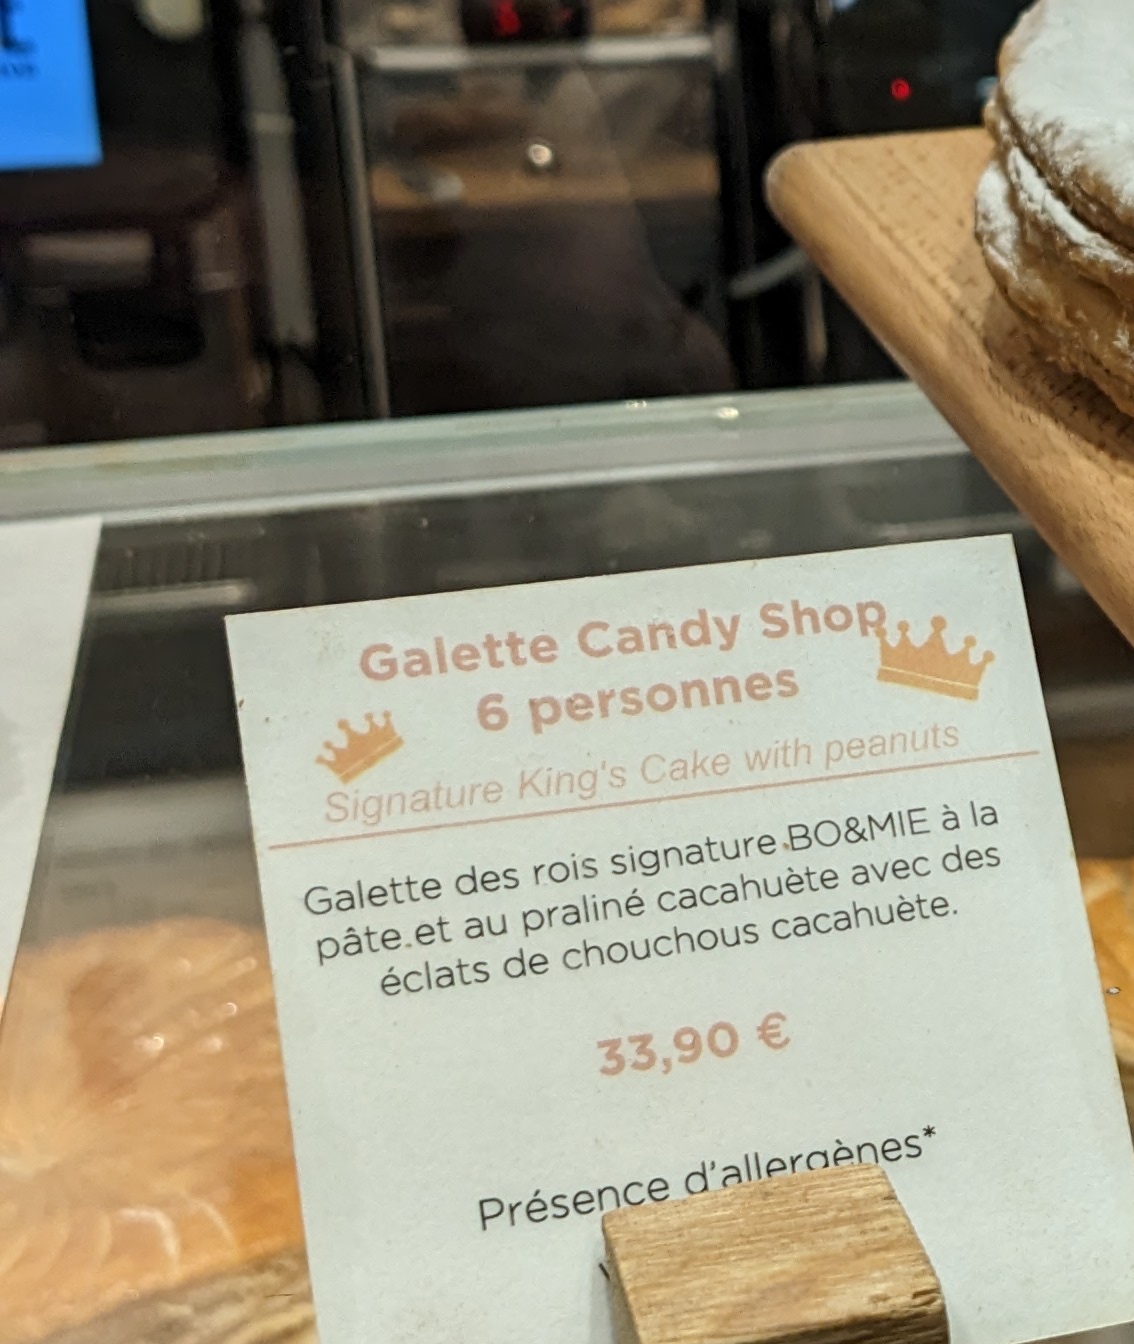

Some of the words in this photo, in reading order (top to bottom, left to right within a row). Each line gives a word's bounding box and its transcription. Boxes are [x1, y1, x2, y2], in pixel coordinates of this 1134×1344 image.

[359, 631, 559, 682] Galette
[576, 608, 741, 659] Candy
[758, 598, 887, 640] Shop
[476, 692, 509, 733] 6
[528, 669, 801, 735] personnes
[325, 780, 503, 826] Signature
[518, 760, 627, 801] King's
[640, 750, 732, 785] Cake
[744, 737, 812, 772] with
[825, 720, 961, 768] peanuts
[303, 873, 443, 915] Galette
[454, 865, 521, 897] des
[533, 852, 599, 886] rois
[610, 833, 778, 878] signature
[787, 806, 932, 852] BO&MIE
[941, 803, 962, 832] à
[969, 800, 999, 828] la
[316, 926, 402, 967] pâte
[415, 915, 453, 946] et
[464, 913, 509, 940] au
[521, 887, 646, 938] praliné
[656, 866, 840, 913] cacahuète
[851, 854, 932, 886] avec
[941, 844, 1002, 874] des
[380, 958, 491, 997] éclats
[503, 947, 550, 979] de
[562, 923, 760, 971] chouchous
[771, 894, 959, 941] cacahuète.
[597, 1020, 740, 1076] 33,90
[756, 1011, 791, 1050] €
[478, 1173, 671, 1232] Présence
